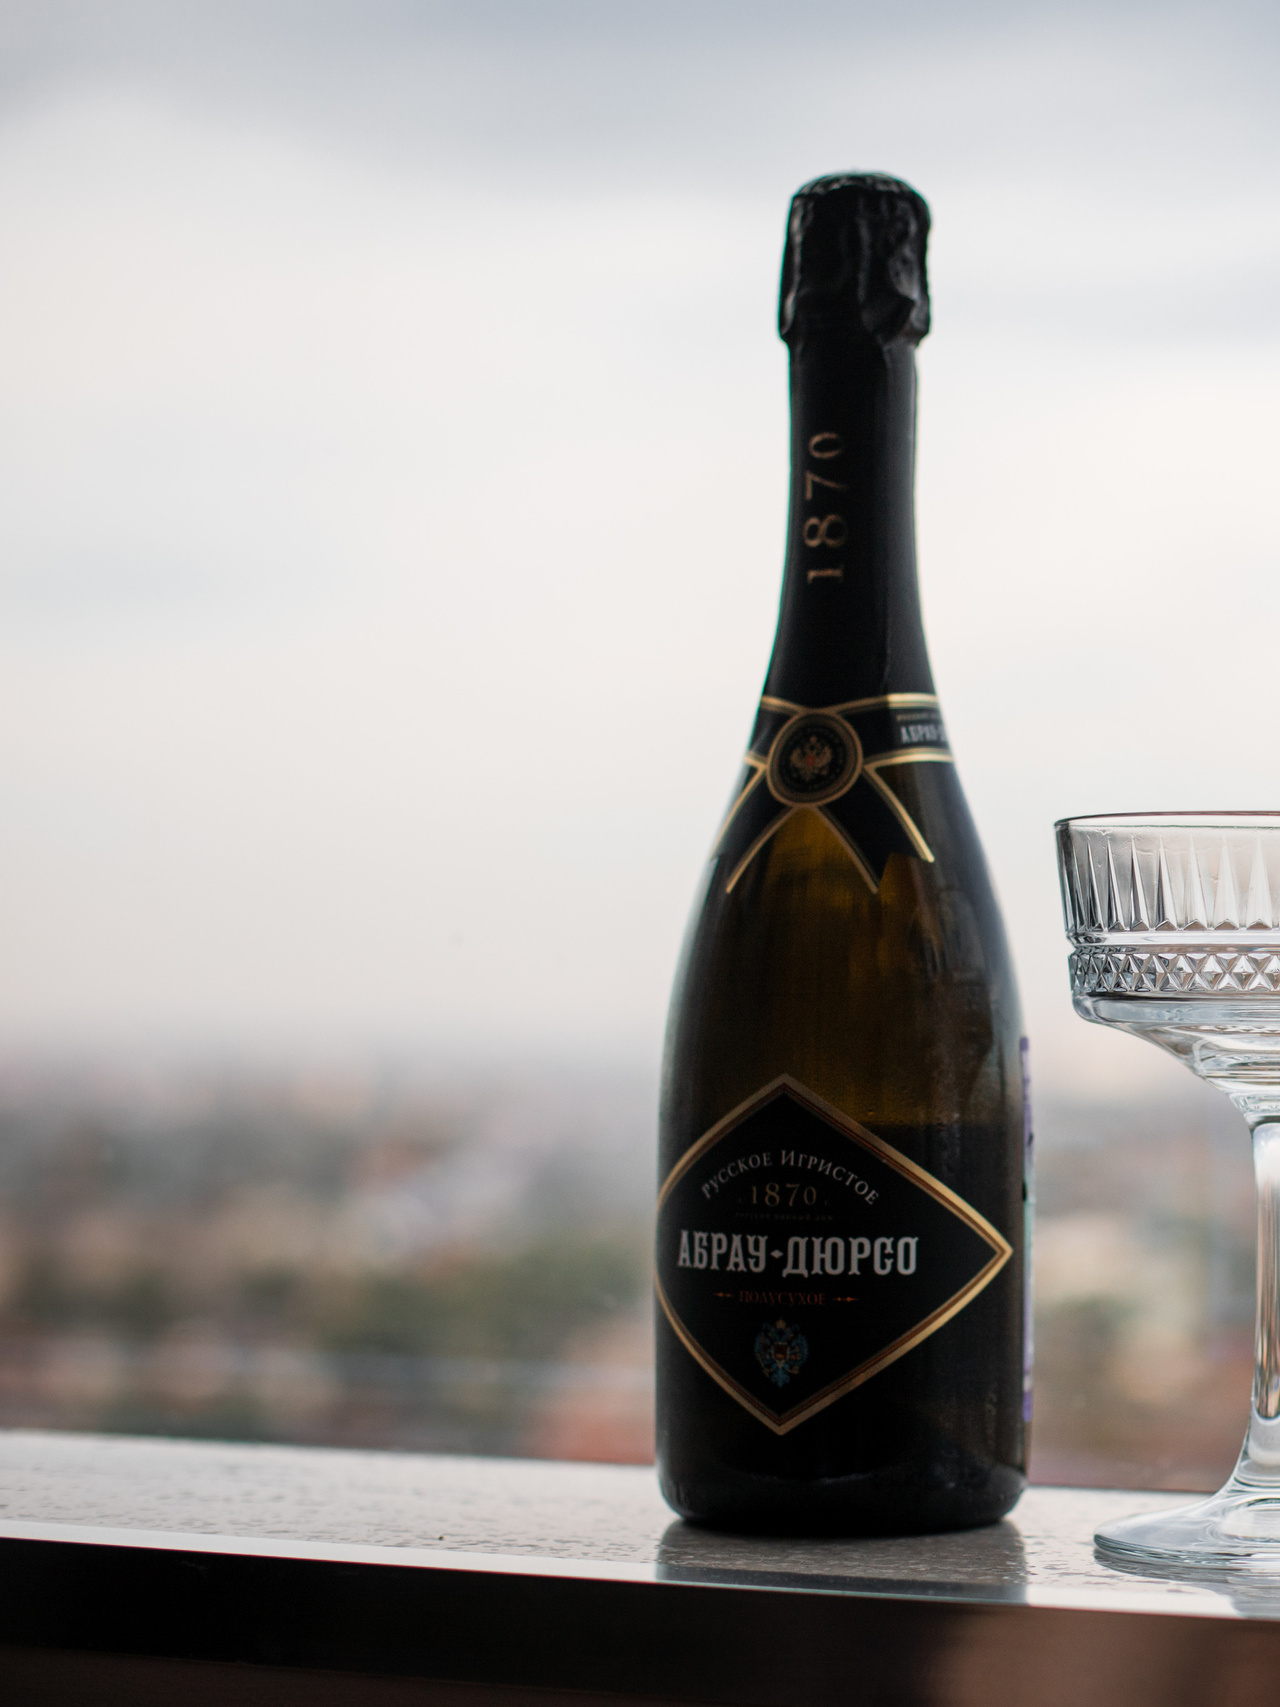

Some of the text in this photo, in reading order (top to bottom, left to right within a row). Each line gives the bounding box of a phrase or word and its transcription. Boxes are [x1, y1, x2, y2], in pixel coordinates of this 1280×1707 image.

[803, 431, 848, 584] 1870
[702, 1150, 879, 1205] РУССКОЕ ИГРИСТОЕ
[752, 1183, 817, 1207] 1870
[678, 1230, 919, 1278] АБРАУ-ДЮРСО
[741, 1291, 825, 1307] ПОЛУСУХОЕ
